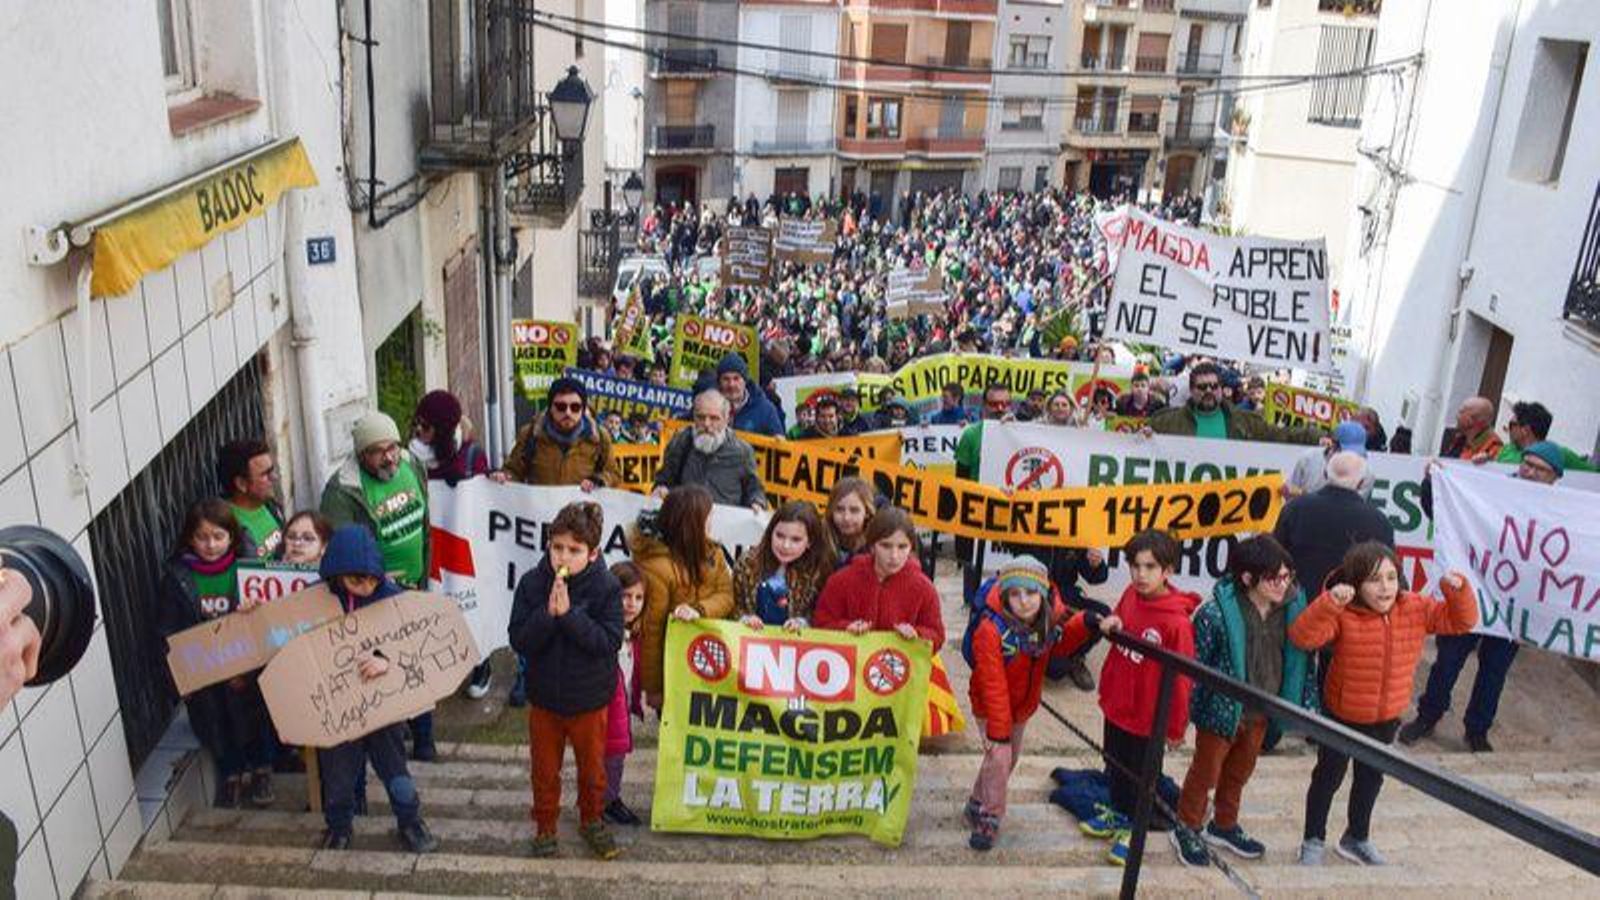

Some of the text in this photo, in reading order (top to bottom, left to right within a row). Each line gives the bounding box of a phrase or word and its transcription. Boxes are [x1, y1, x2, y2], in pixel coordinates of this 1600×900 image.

[196, 164, 264, 233] BADOC
[310, 242, 331, 261] 36
[1138, 263, 1312, 323] EL POBLE
[703, 324, 735, 346] NO
[1114, 302, 1321, 363] NO SE VEN!
[923, 364, 949, 393] NO
[1294, 394, 1333, 421] NO
[873, 469, 929, 518] DEL
[937, 486, 1087, 538] DECRET
[1104, 485, 1270, 537] 14/2020
[1499, 515, 1570, 567] NO
[201, 597, 230, 613] NO
[743, 642, 851, 698] NO
[688, 691, 899, 744] MAGDA
[684, 734, 896, 779] DEFENSEM
[683, 771, 890, 816] LA TERRA
